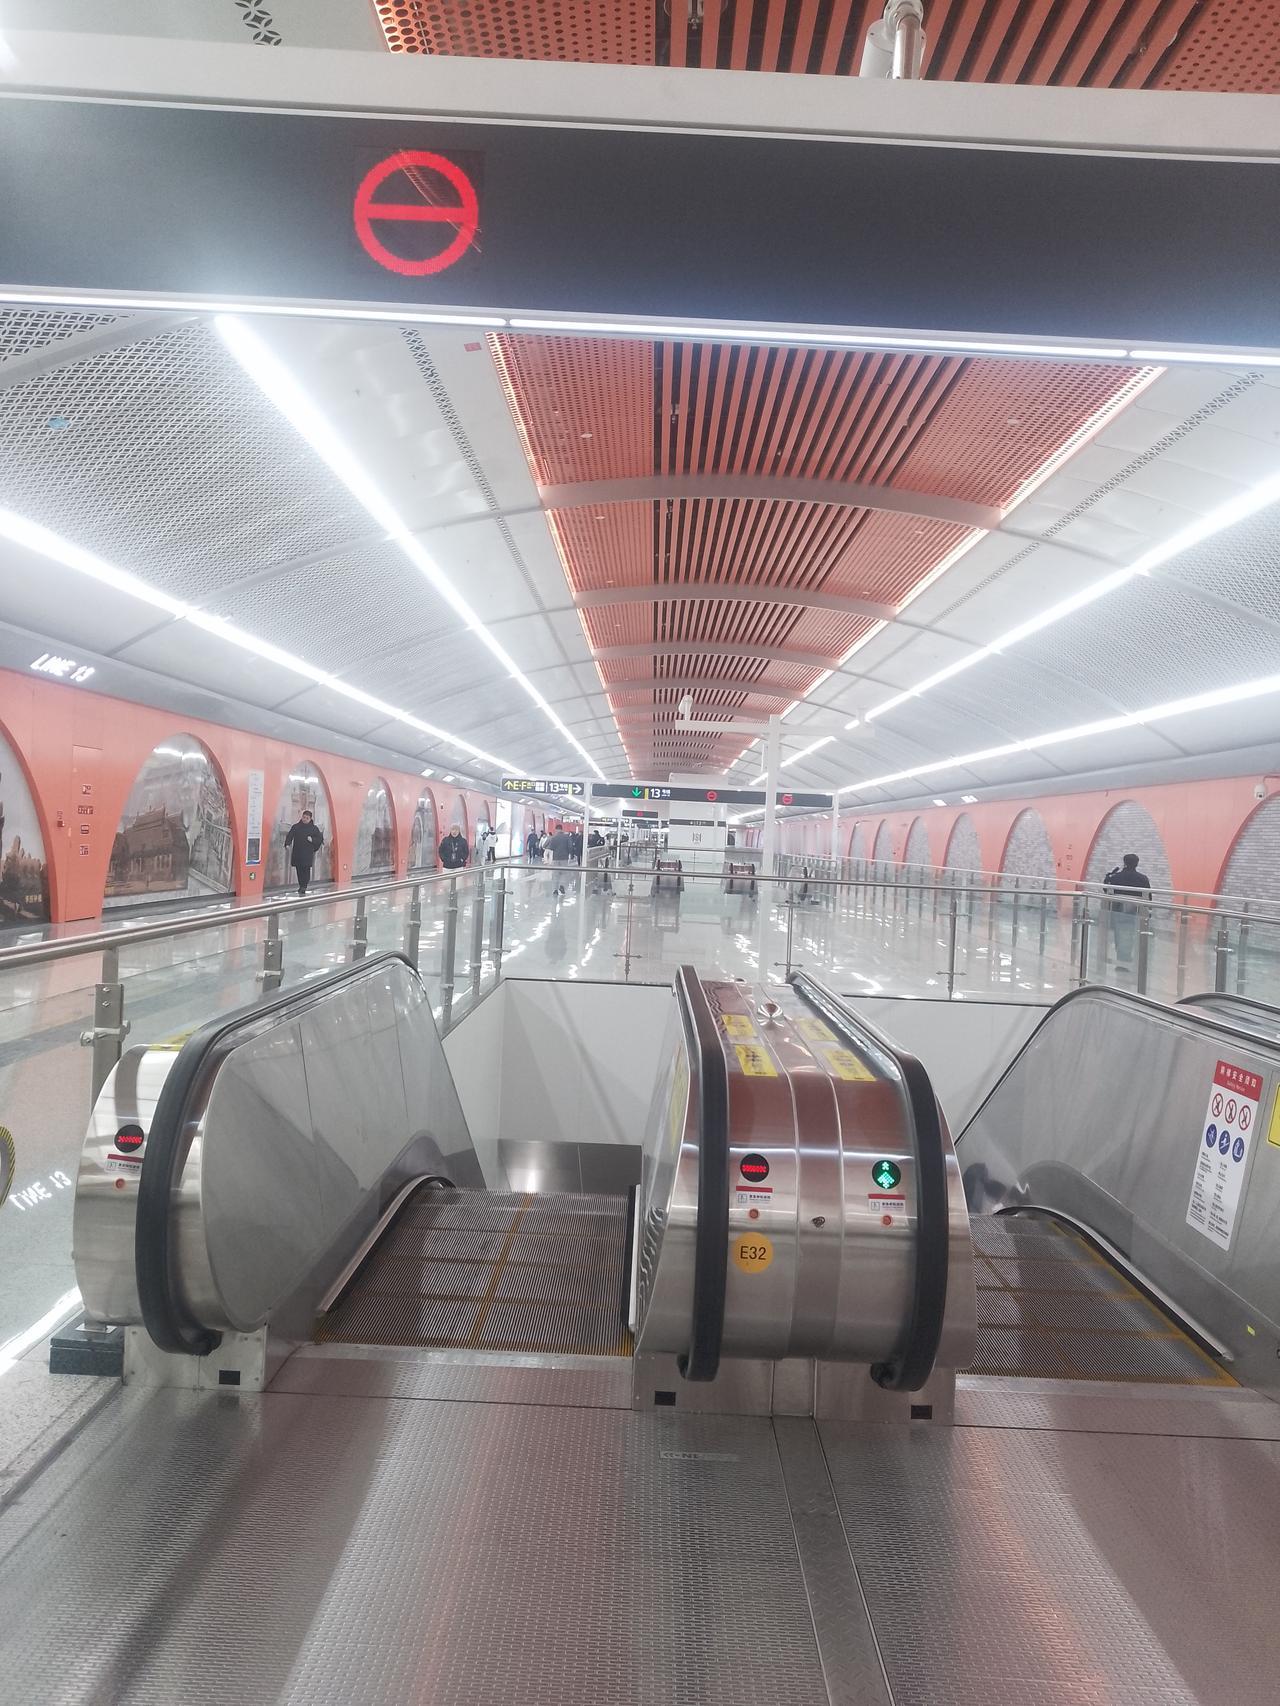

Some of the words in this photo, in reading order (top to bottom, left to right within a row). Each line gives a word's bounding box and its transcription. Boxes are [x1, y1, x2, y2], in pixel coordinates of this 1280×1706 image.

[549, 782, 559, 793] 13
[650, 788, 661, 798] 13
[740, 1245, 767, 1261] E32
